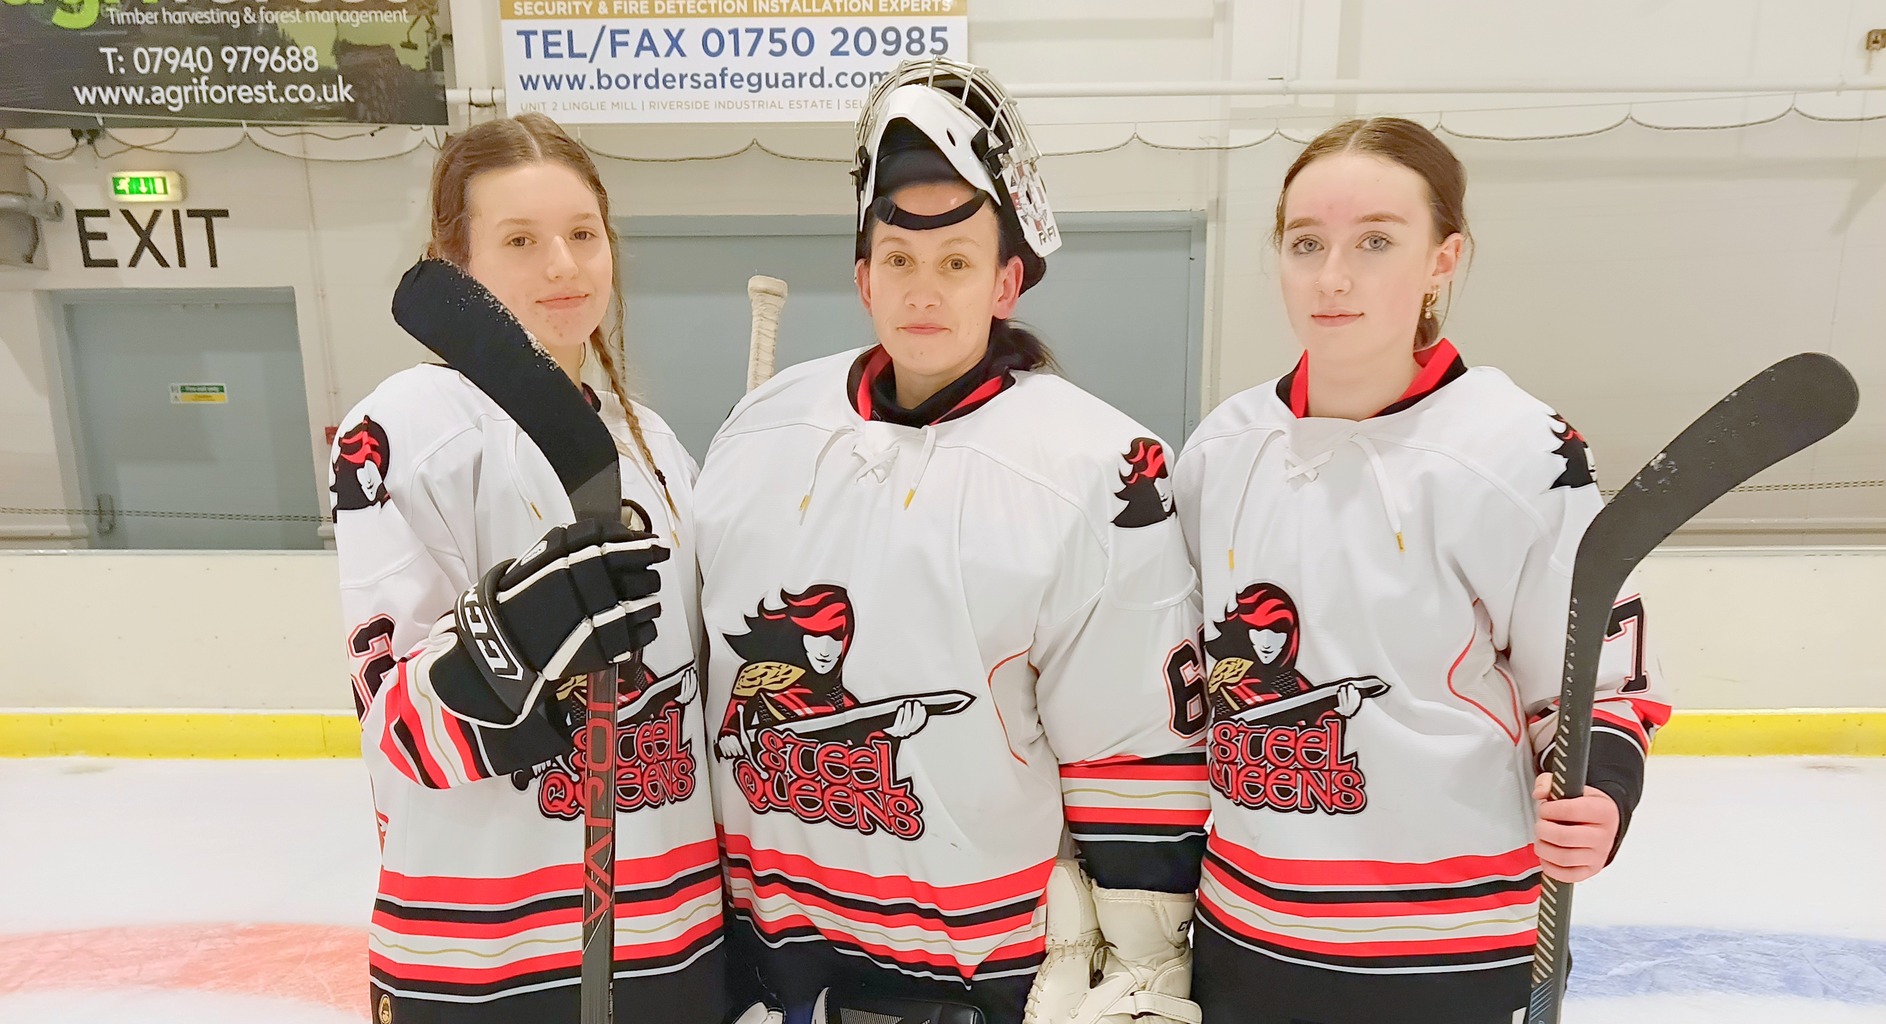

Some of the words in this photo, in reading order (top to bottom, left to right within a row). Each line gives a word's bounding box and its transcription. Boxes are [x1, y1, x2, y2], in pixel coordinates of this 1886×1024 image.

[109, 7, 158, 26] Timber
[162, 6, 241, 29] harvesting
[243, 6, 257, 24] &
[260, 5, 302, 24] forest
[305, 8, 409, 28] management
[513, 0, 593, 16] SECURITY
[597, 1, 608, 15] &
[613, 0, 651, 15] FIRE
[654, 0, 748, 15] DETECTION
[753, 0, 874, 14] INSTALLATION
[878, 0, 952, 13] EXPERTS
[516, 25, 687, 64] TEL/FAX
[701, 26, 815, 58] 01750
[829, 26, 949, 57] 20985
[99, 47, 125, 74] T:
[133, 47, 213, 74] 07940
[220, 46, 319, 73] 979688
[73, 75, 355, 112] www.agriforest.co.uk
[518, 66, 891, 94] www.bordersafeguard.com
[520, 102, 547, 113] UNIT
[552, 102, 558, 112] 2
[562, 102, 607, 112] LINGLIE
[611, 101, 637, 111] MILL
[649, 101, 710, 111] RIVERSIDE
[714, 100, 784, 110] INDUSTRIAL
[788, 100, 833, 110] ESTATE
[75, 207, 229, 269] EXIT
